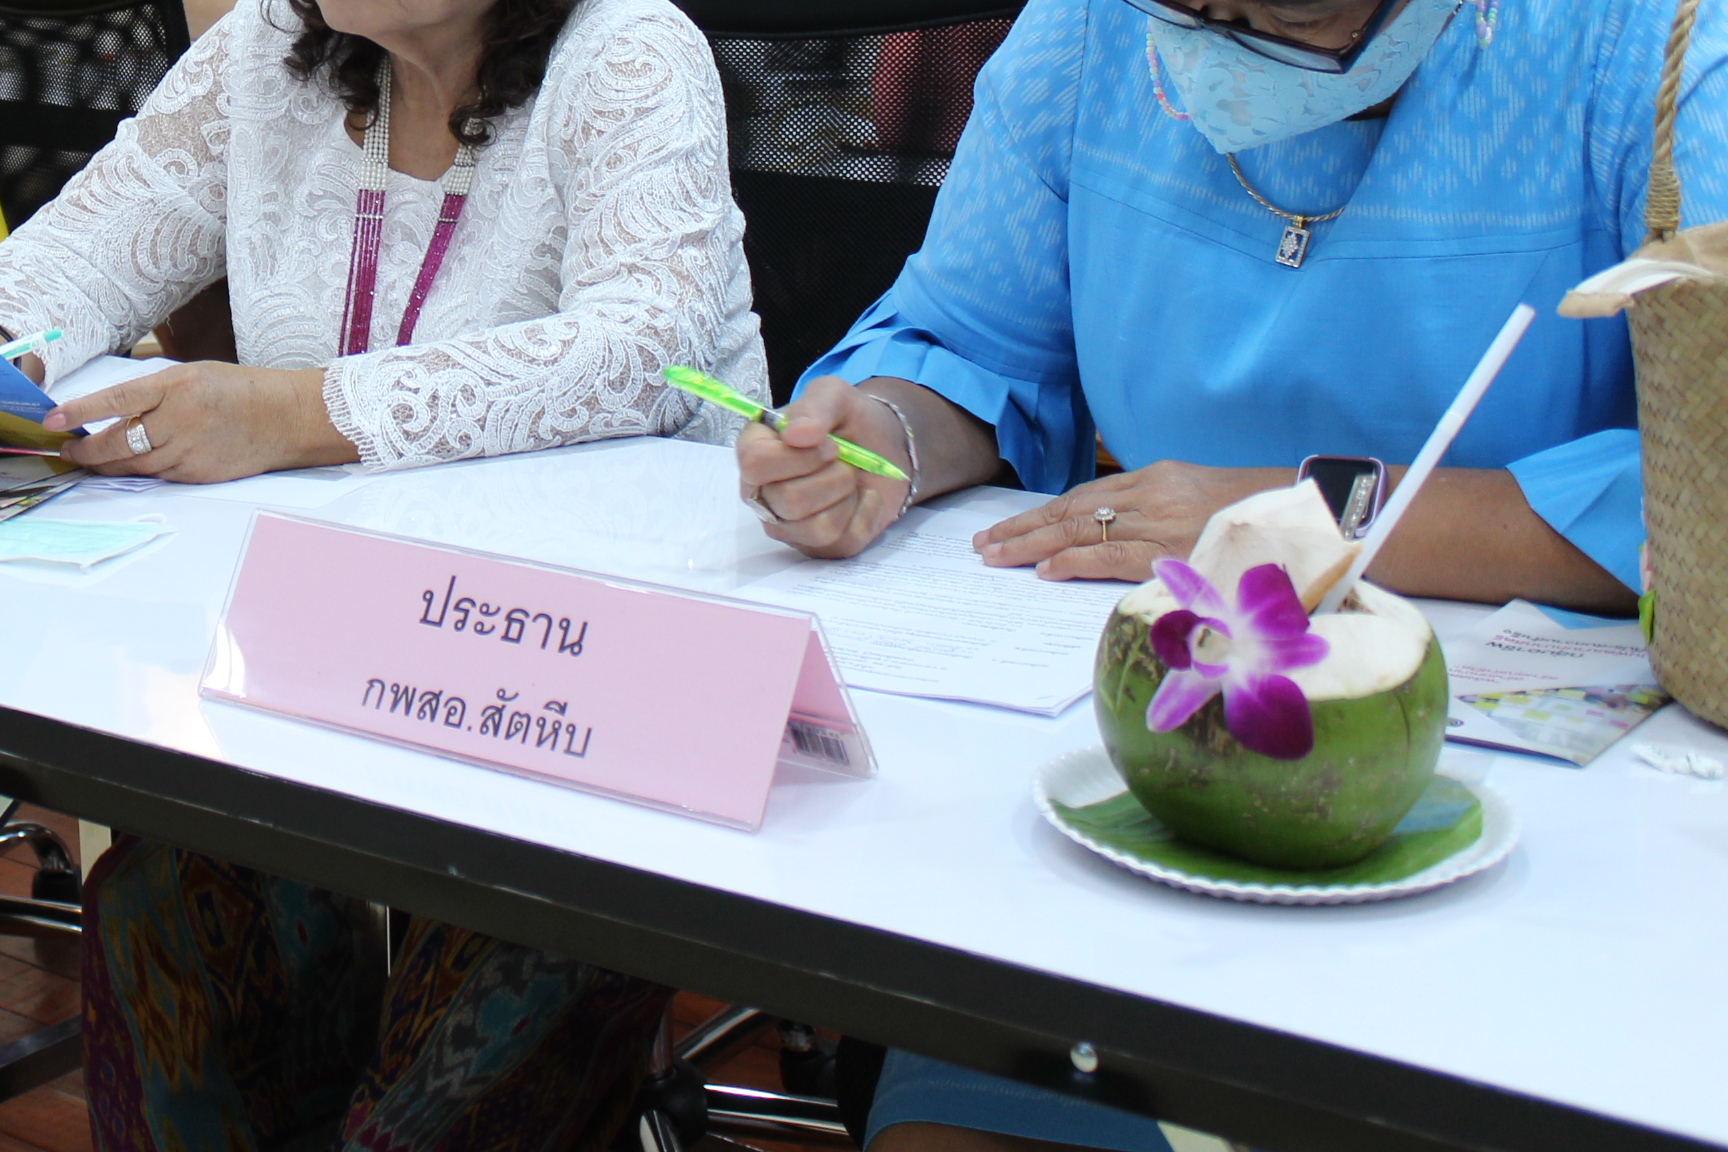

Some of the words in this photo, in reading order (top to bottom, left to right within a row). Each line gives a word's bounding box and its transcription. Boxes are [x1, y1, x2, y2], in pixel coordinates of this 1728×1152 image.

[420, 575, 588, 656] ประธาน
[362, 678, 592, 759] กพสอ.สัตหีบ
